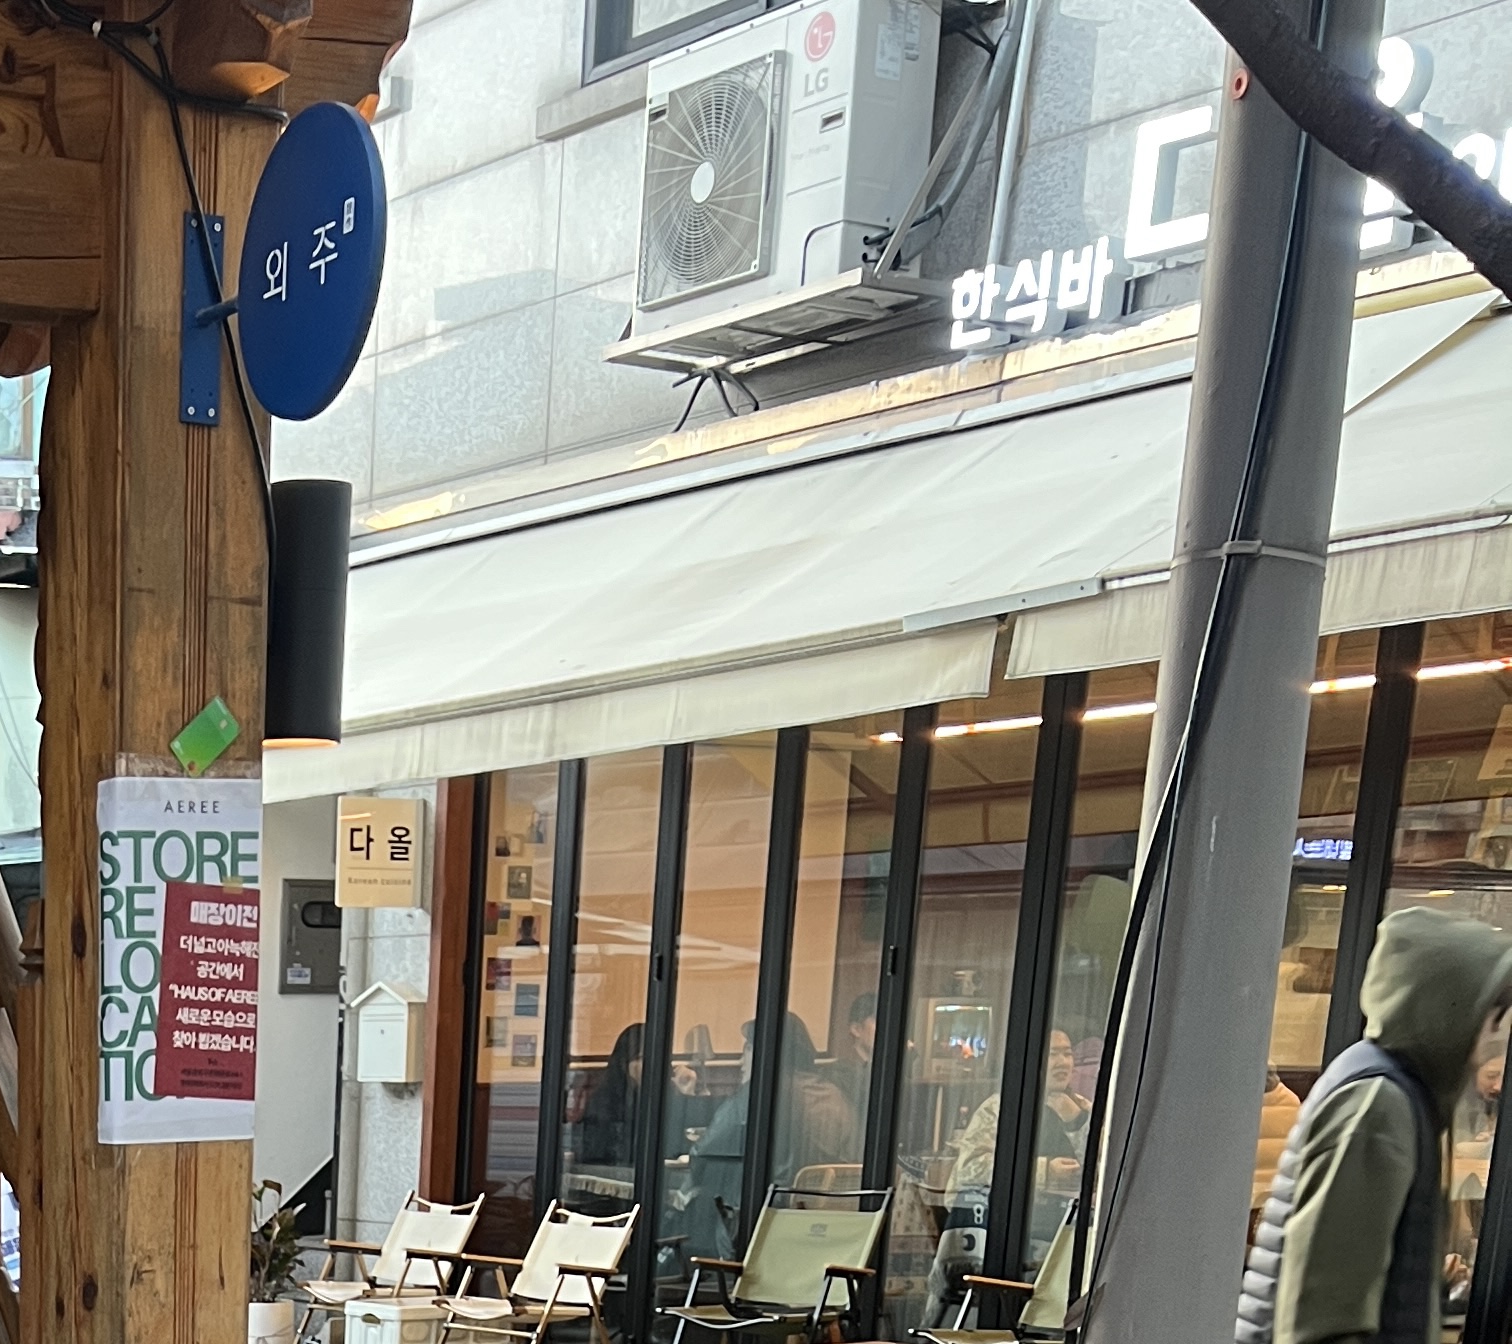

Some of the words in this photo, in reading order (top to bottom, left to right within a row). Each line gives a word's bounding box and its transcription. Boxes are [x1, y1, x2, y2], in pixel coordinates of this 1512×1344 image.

[804, 68, 829, 97] LG
[950, 236, 1114, 349] 한식바
[164, 800, 220, 814] AEREE
[100, 829, 259, 886] STORE
[101, 886, 157, 939] RE
[190, 901, 258, 929] 매장이전
[101, 940, 161, 995] LO
[196, 961, 244, 981] 공간에서
[100, 995, 158, 1048] CA
